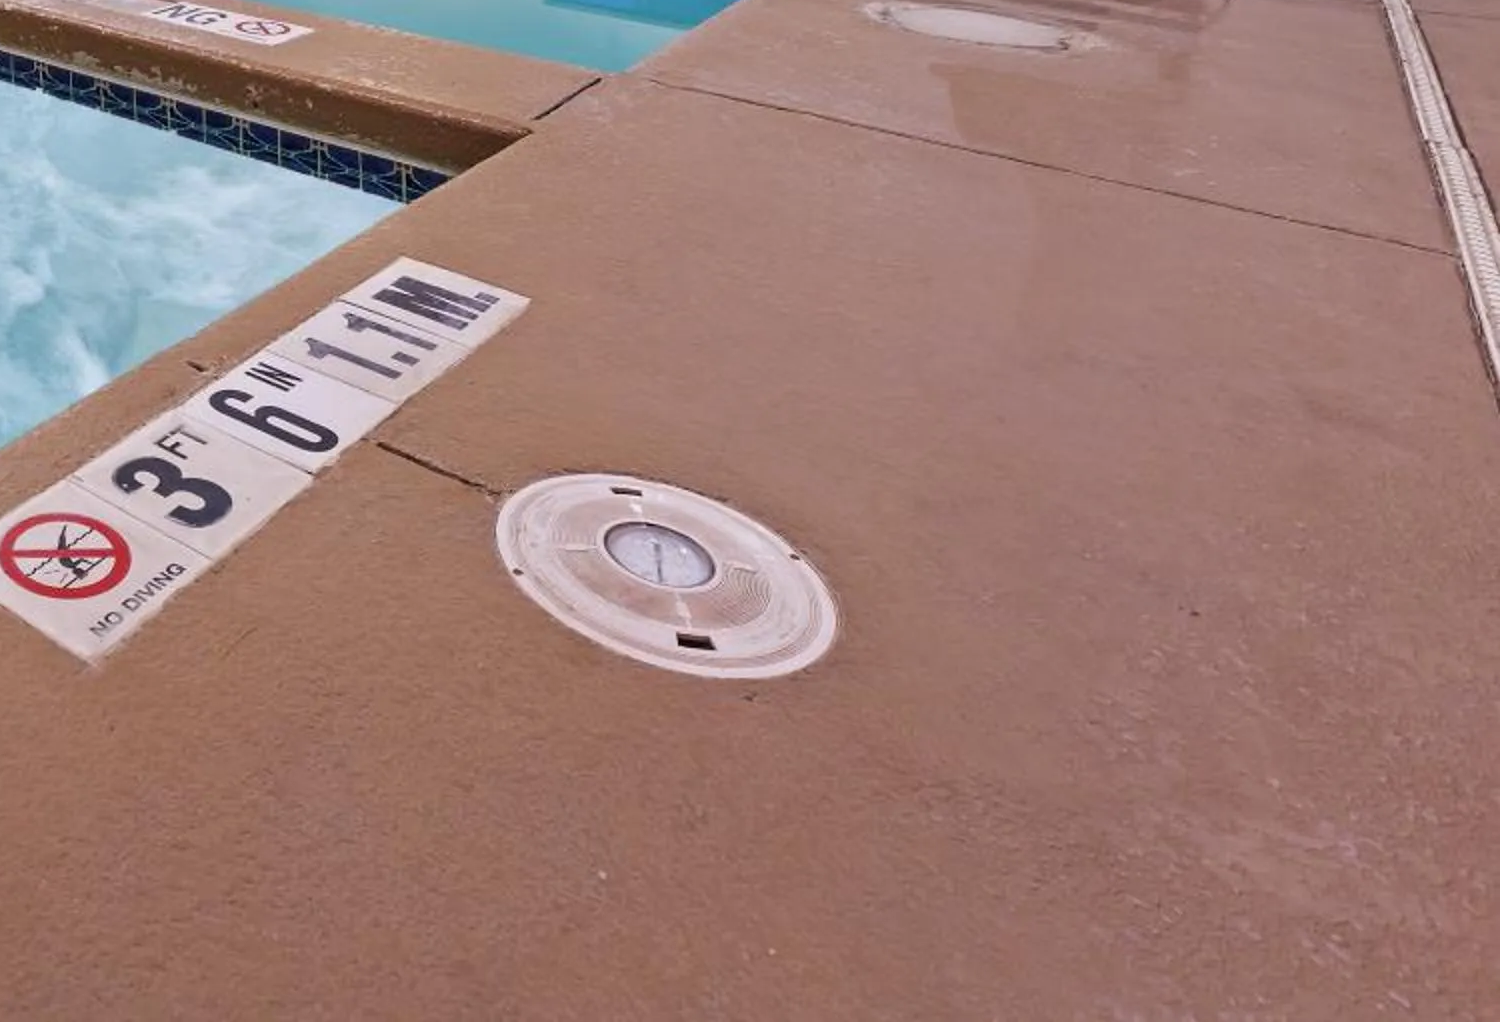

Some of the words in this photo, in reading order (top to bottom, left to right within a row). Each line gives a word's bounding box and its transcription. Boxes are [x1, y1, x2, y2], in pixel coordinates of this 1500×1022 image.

[244, 362, 304, 392] IN
[303, 311, 439, 380] 1.1
[153, 424, 209, 462] FT
[208, 387, 339, 454] 6
[111, 456, 233, 529] 3
[89, 611, 124, 639] NO
[121, 563, 188, 613] DIVING
